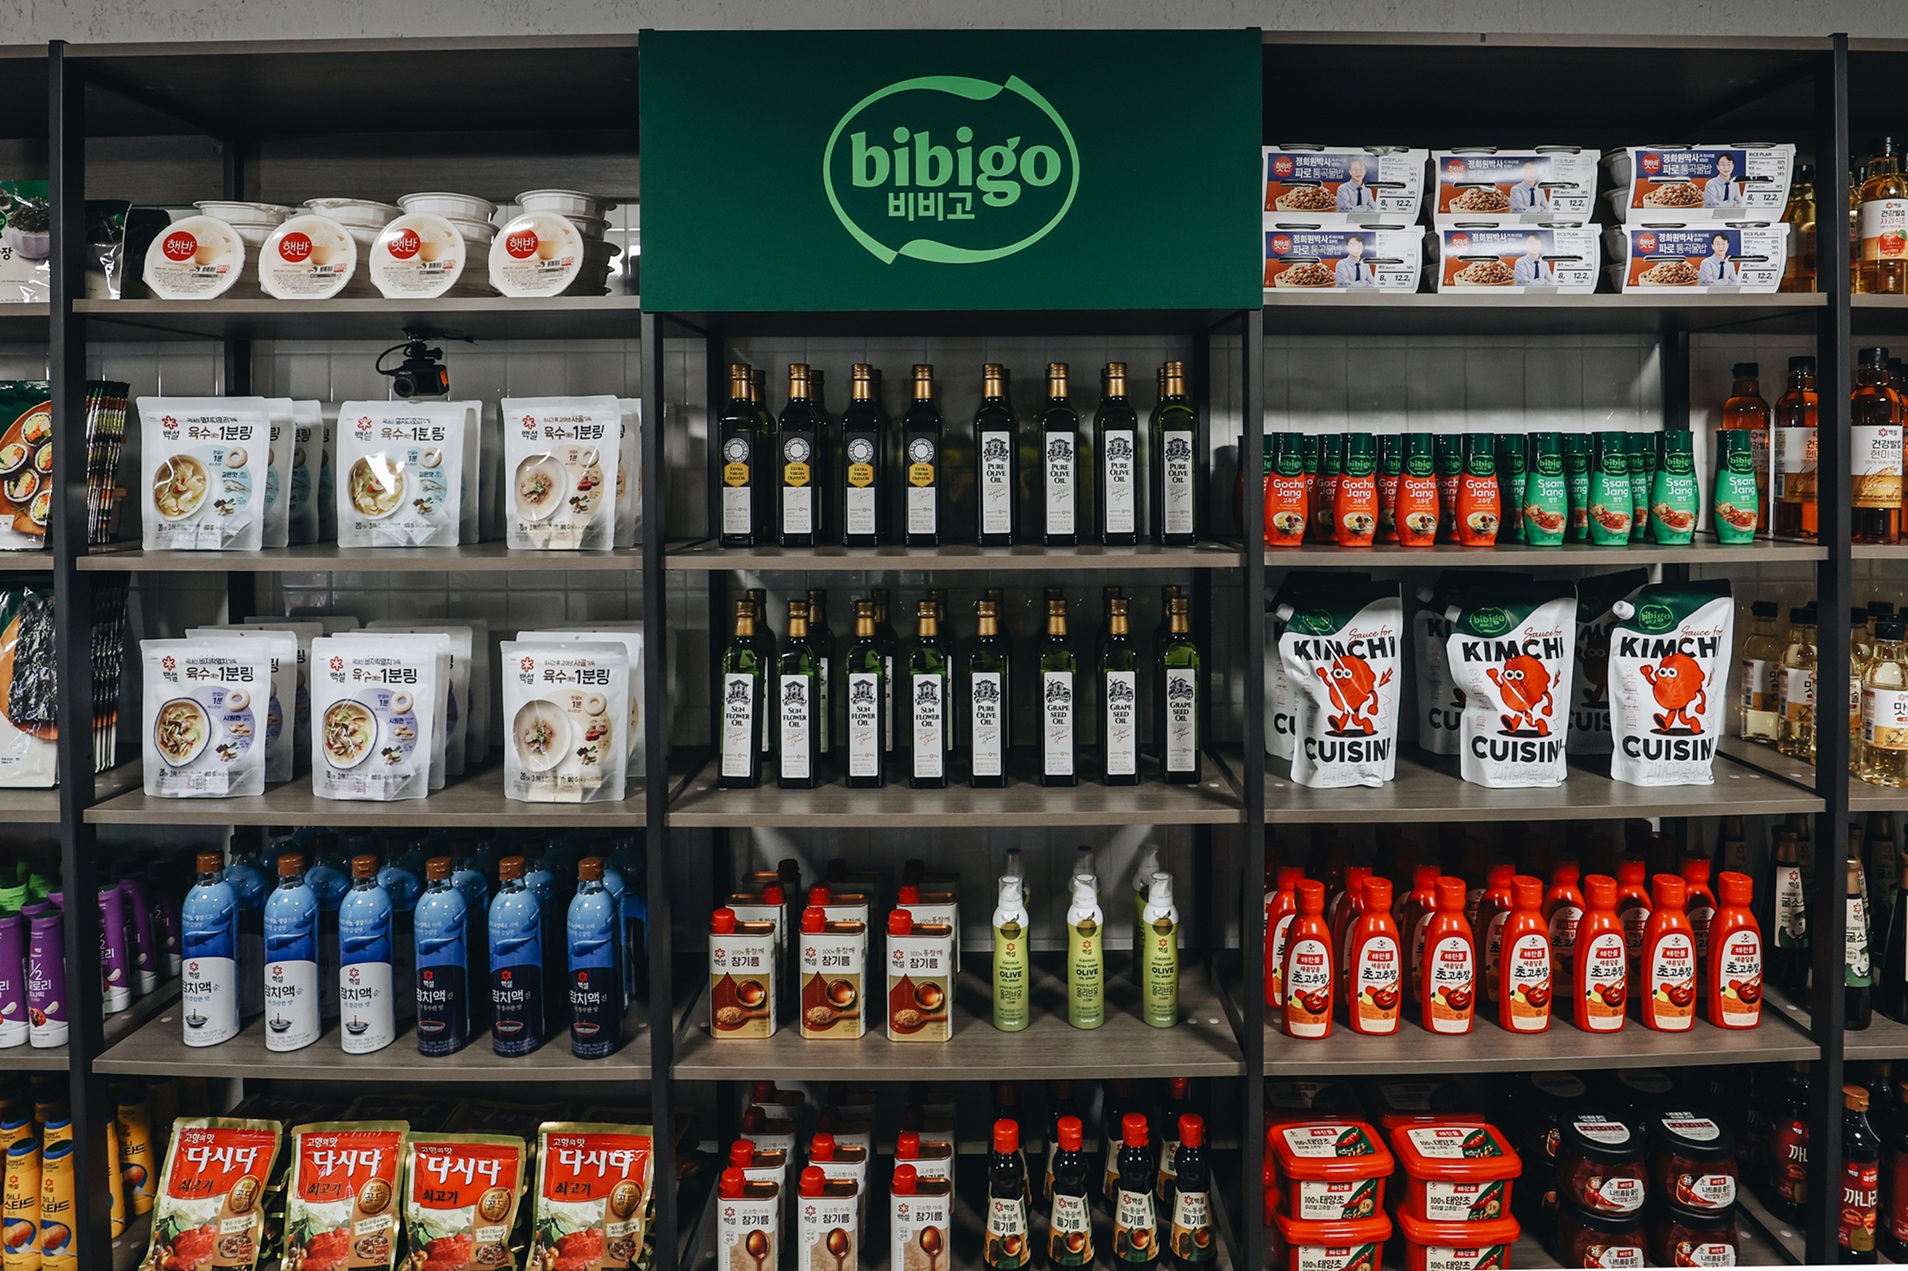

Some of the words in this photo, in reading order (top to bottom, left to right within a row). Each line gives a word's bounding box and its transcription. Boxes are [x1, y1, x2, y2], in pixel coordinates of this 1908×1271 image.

[850, 126, 1061, 207] bibigo
[888, 192, 975, 222] 비비고
[167, 239, 194, 256] 햇반
[283, 240, 308, 257] 햇반
[509, 237, 535, 253] 햇반
[163, 430, 180, 440] 백설
[219, 425, 253, 440] 1분링
[355, 431, 372, 441] 백설
[411, 426, 445, 441] 1분링
[521, 430, 538, 440] 백설
[573, 425, 605, 440] 1분링
[1273, 479, 1304, 489] Gochu
[1342, 479, 1374, 489] Gochu
[1405, 479, 1435, 489] Gochu
[1466, 479, 1497, 489] Gochu
[1537, 478, 1564, 488] Ssam
[1602, 478, 1629, 488] Ssam
[1665, 477, 1693, 487] Ssam
[1729, 477, 1755, 486] Ssam
[1277, 488, 1302, 499] Jang
[1346, 488, 1371, 499] Jang
[1409, 489, 1434, 500] Jang
[1470, 488, 1496, 499] Jang
[1539, 488, 1564, 498] Jang
[1604, 487, 1629, 498] Jang
[1668, 486, 1692, 497] Jang
[1732, 486, 1755, 496] Jang
[1474, 613, 1505, 626] bibigo
[1641, 610, 1671, 623] bibigo
[1348, 627, 1379, 643] Sauce
[1523, 627, 1553, 643] Sauce
[1680, 625, 1711, 642] Sauce
[1293, 636, 1395, 662] KIMCHI
[1461, 637, 1564, 662] KIMCHI
[1620, 636, 1721, 659] KIMCHI
[162, 671, 178, 682] 백설
[218, 666, 254, 682] 1분링
[330, 672, 346, 683] 백설
[380, 668, 417, 684] 1분링
[519, 673, 534, 684] 백설
[575, 669, 610, 685] 1분링
[1169, 701, 1193, 709] GRAPE
[980, 718, 993, 726] OIL
[1304, 737, 1391, 763] CUISIN
[1471, 736, 1562, 763] CUISIN
[1523, 949, 1543, 958] 해찬들
[1599, 948, 1619, 957] 해찬들
[1667, 948, 1687, 957] 해찬들
[1735, 945, 1755, 955] 해찬들
[731, 956, 760, 967] 참기름
[822, 956, 851, 967] 참기름
[1300, 956, 1321, 965] 해찬들
[1371, 951, 1391, 961] 해찬들
[1444, 952, 1467, 961] 해찬들
[909, 958, 938, 969] 참기름
[1726, 961, 1760, 975] 초고추장
[1076, 968, 1098, 976] OLIVE
[1151, 966, 1174, 974] OLIVE
[1361, 967, 1397, 981] 초고추장
[1435, 967, 1471, 981] 초고추장
[1514, 965, 1549, 979] 초고추장
[1590, 964, 1625, 978] 초고추장
[1656, 965, 1692, 978] 초고추장
[1292, 970, 1328, 985] 초고추장
[184, 1133, 206, 1143] 고향의
[206, 1133, 215, 1143] 맛
[307, 1137, 328, 1147] 고향의
[328, 1137, 338, 1147] 맛
[553, 1137, 575, 1147] 고향의
[575, 1138, 586, 1148] 맛
[1308, 1138, 1332, 1146] 태양초
[1433, 1138, 1458, 1146] 태양초
[420, 1146, 443, 1154] 고향의
[443, 1146, 453, 1155] 맛
[187, 1147, 258, 1174] 다시다
[313, 1149, 383, 1177] 다시다
[559, 1149, 635, 1179] 다시다
[427, 1157, 502, 1186] 다시다
[177, 1178, 215, 1192] 쇠고기
[307, 1182, 342, 1196] 쇠고기
[555, 1181, 591, 1196] 쇠고기
[422, 1190, 459, 1204] 쇠고기
[1304, 1196, 1319, 1204] 100%
[1320, 1194, 1345, 1205] 태양초
[1445, 1195, 1471, 1206] 태양초
[742, 1215, 769, 1225] 참기름
[822, 1213, 850, 1224] 참기름
[915, 1211, 943, 1222] 참기름
[1121, 1215, 1145, 1226] 들기름
[1183, 1214, 1207, 1225] 들기름
[993, 1222, 1016, 1233] 들기름
[1057, 1219, 1080, 1230] 들기름
[1317, 1259, 1342, 1269] 태양초
[1430, 1261, 1445, 1269] 100%
[1445, 1260, 1471, 1270] 태양초
